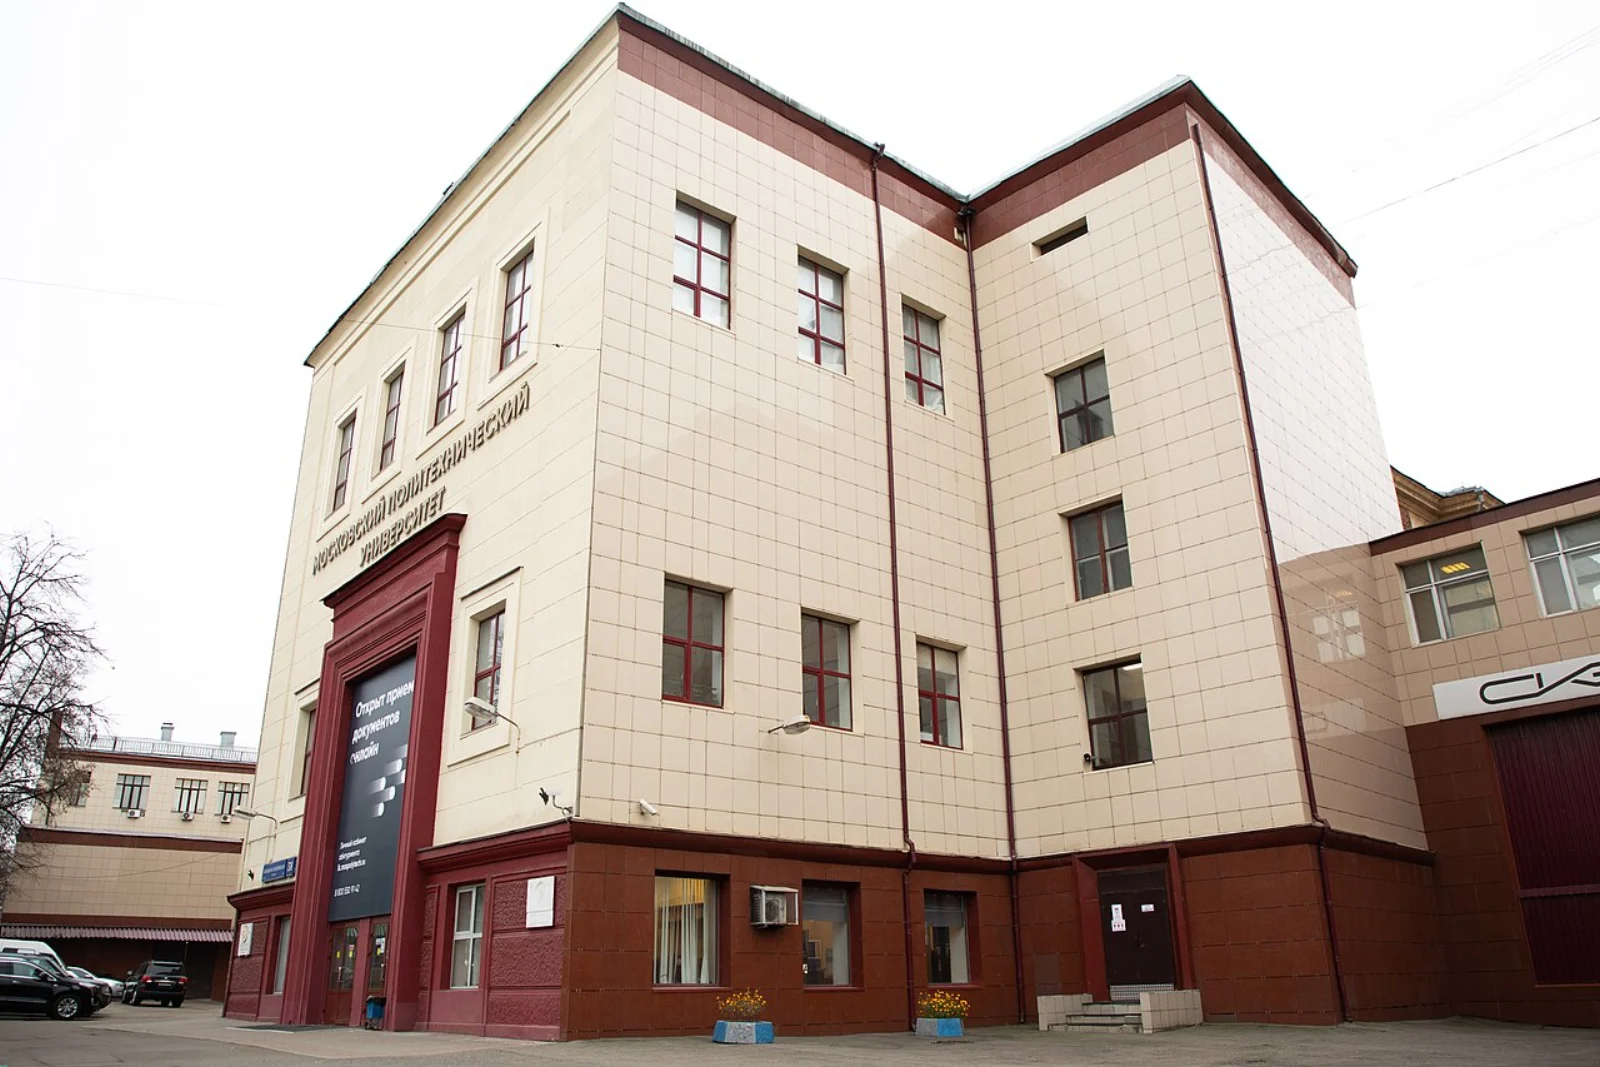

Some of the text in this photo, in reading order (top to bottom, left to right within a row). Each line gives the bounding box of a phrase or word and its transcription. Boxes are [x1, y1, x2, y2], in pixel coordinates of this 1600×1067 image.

[312, 381, 531, 576] МОСКОВСКИЙ ПОЛИТЕХНИЧЕСКИЙ
[359, 485, 446, 568] УНИВЕРСИТЕТ
[355, 693, 386, 718] Открыт
[351, 710, 401, 745] документов
[349, 741, 380, 765] онлайн
